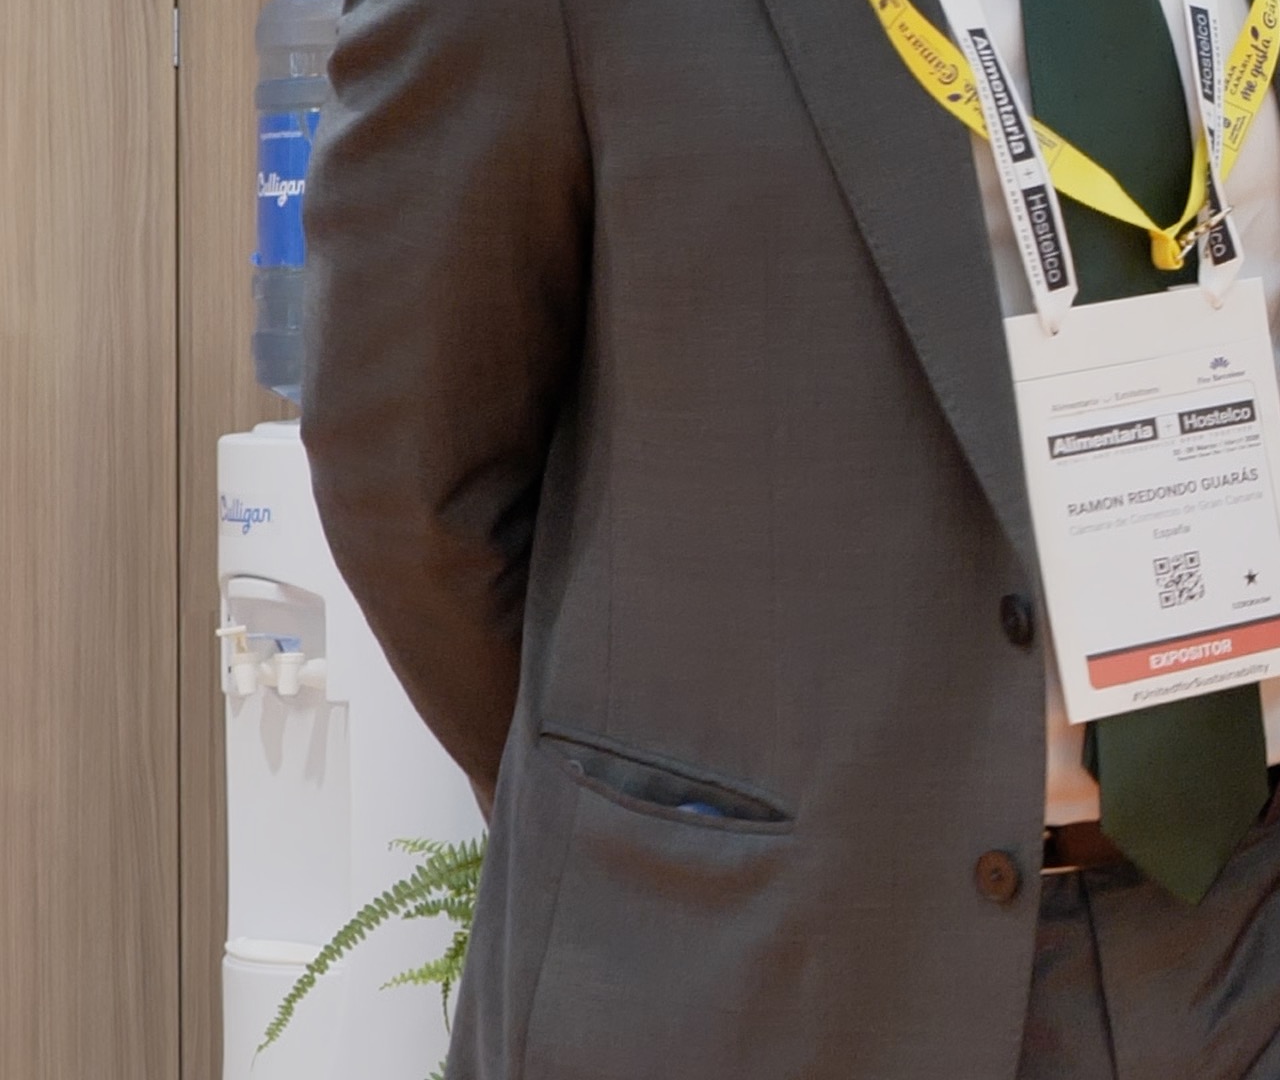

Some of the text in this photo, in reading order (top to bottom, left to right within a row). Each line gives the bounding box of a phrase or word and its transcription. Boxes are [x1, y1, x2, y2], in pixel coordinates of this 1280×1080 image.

[898, 22, 960, 85] Cámara
[1197, 12, 1215, 96] Hostelco
[972, 35, 1026, 156] Alimentaria
[1027, 191, 1062, 283] Hostelco
[1182, 406, 1252, 430] Hostelco
[1128, 480, 1198, 504] REDONDO
[1201, 466, 1259, 492] GUARÁS
[1150, 638, 1232, 669] EXPOSITOR
